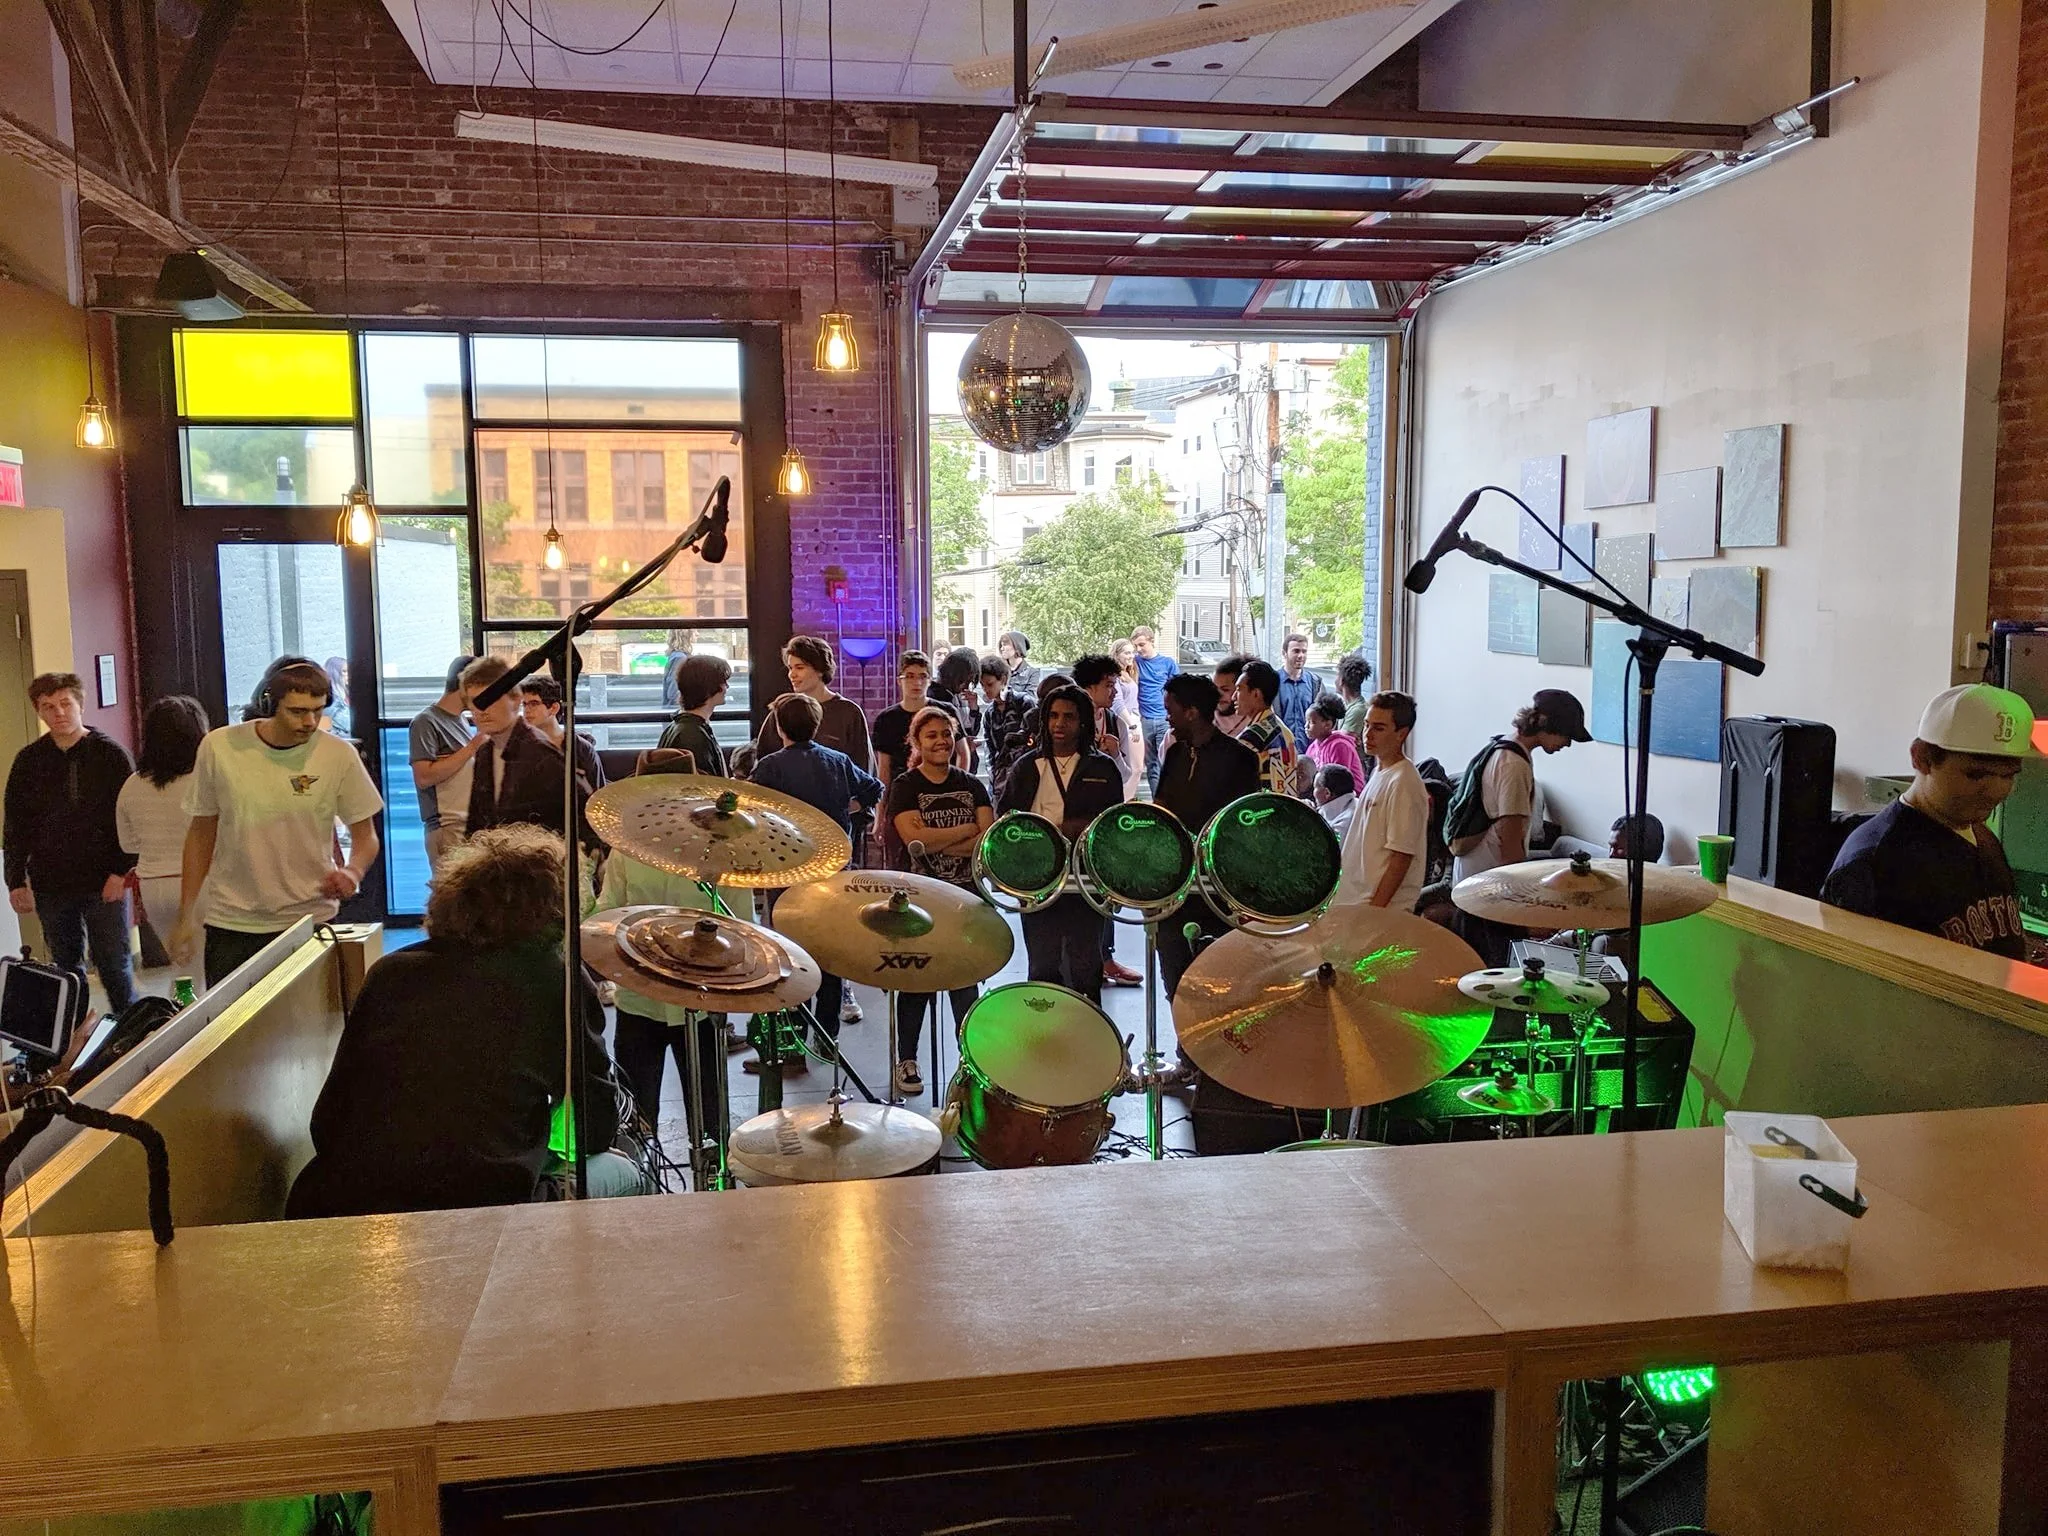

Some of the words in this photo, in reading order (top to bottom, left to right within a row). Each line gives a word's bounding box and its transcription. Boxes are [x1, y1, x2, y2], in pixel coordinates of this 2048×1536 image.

[1994, 712, 2017, 742] B
[1277, 780, 1284, 790] R
[1941, 895, 2021, 947] BOSTO
[873, 954, 933, 973] AAX
